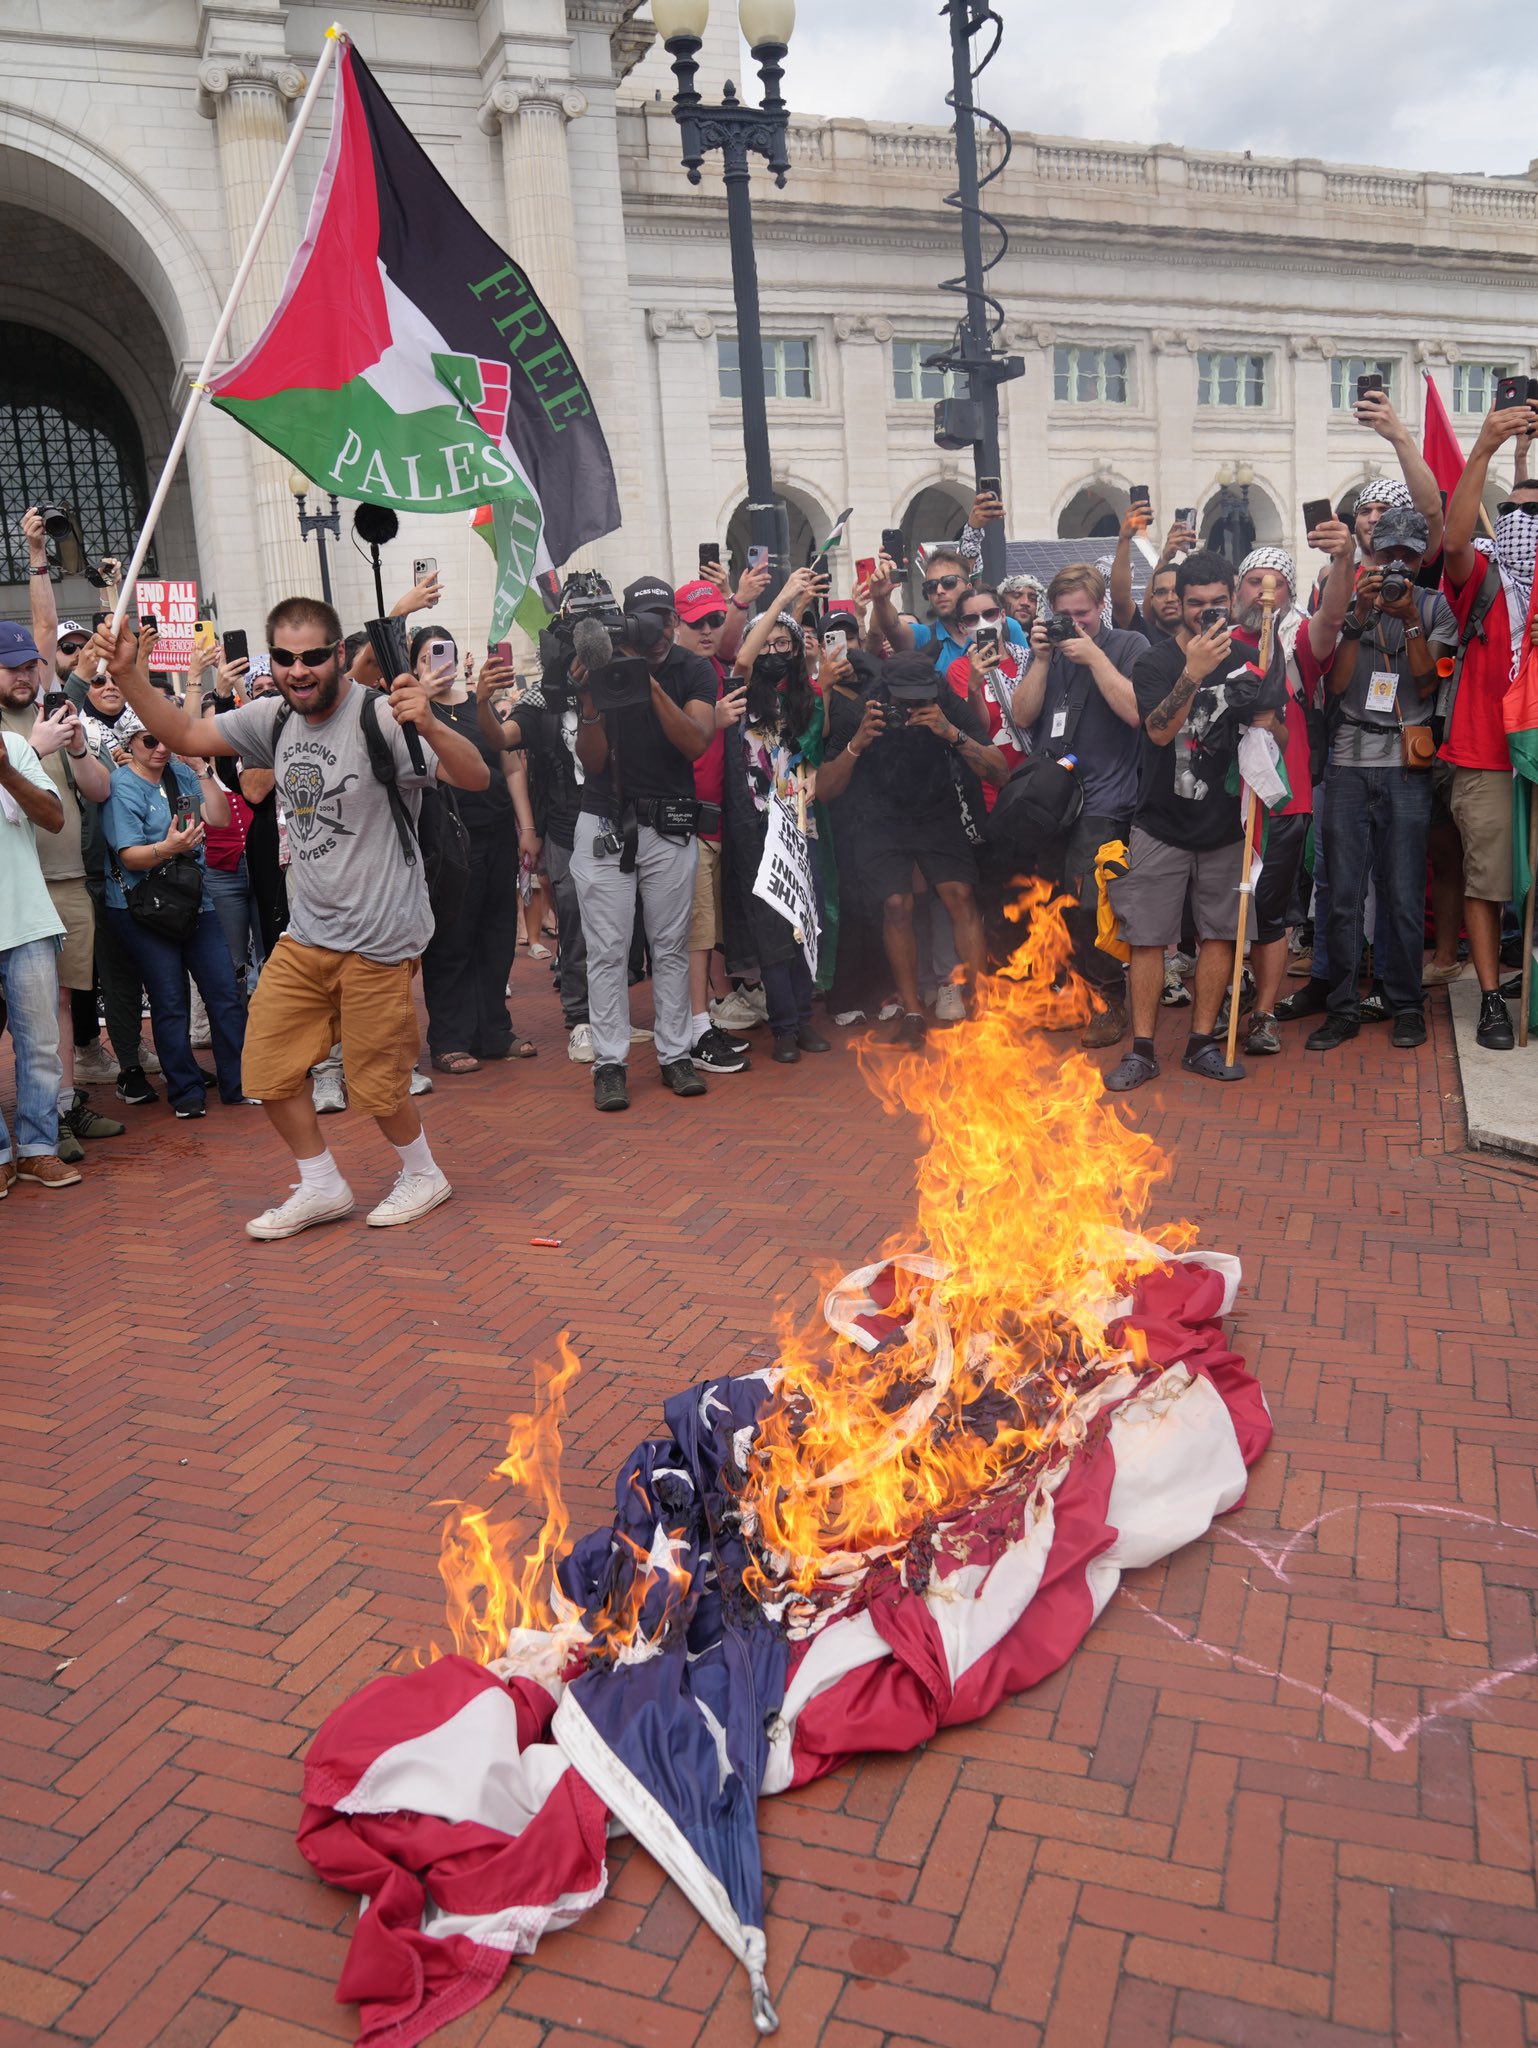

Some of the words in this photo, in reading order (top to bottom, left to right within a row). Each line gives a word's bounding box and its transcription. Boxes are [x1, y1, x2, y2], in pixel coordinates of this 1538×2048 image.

[467, 261, 591, 433] FREE
[136, 583, 165, 603] END
[168, 583, 197, 603] ALL
[651, 588, 669, 596] NEWS
[137, 603, 166, 623] US.
[169, 603, 197, 623] AID
[157, 623, 194, 638] ISRAE
[766, 872, 797, 914] THE
